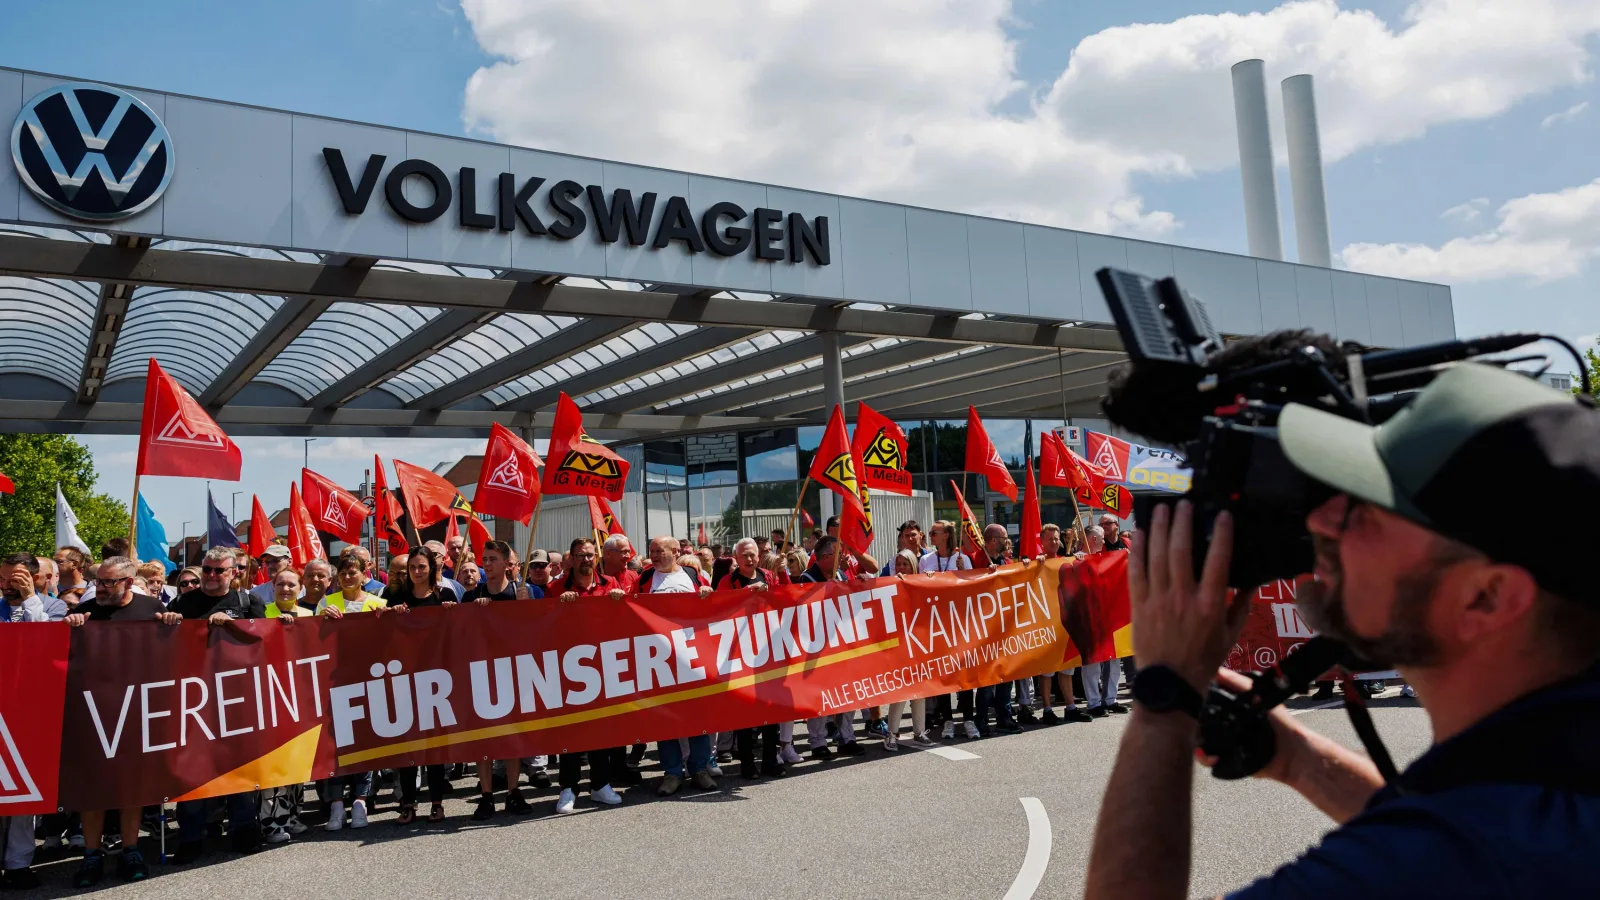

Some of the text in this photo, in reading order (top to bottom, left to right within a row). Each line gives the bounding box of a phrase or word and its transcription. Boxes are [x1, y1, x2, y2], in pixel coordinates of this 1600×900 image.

[322, 147, 831, 266] VOLKSWAGEN
[552, 471, 622, 493] IG Metall
[873, 469, 909, 485] Metall
[83, 577, 1051, 759] VEREINT FÜR UNSERE ZUKUNFT KÄMPFEN
[821, 625, 1057, 712] ALLE BELEGSCHAFTEN IM VW-KONZERN
